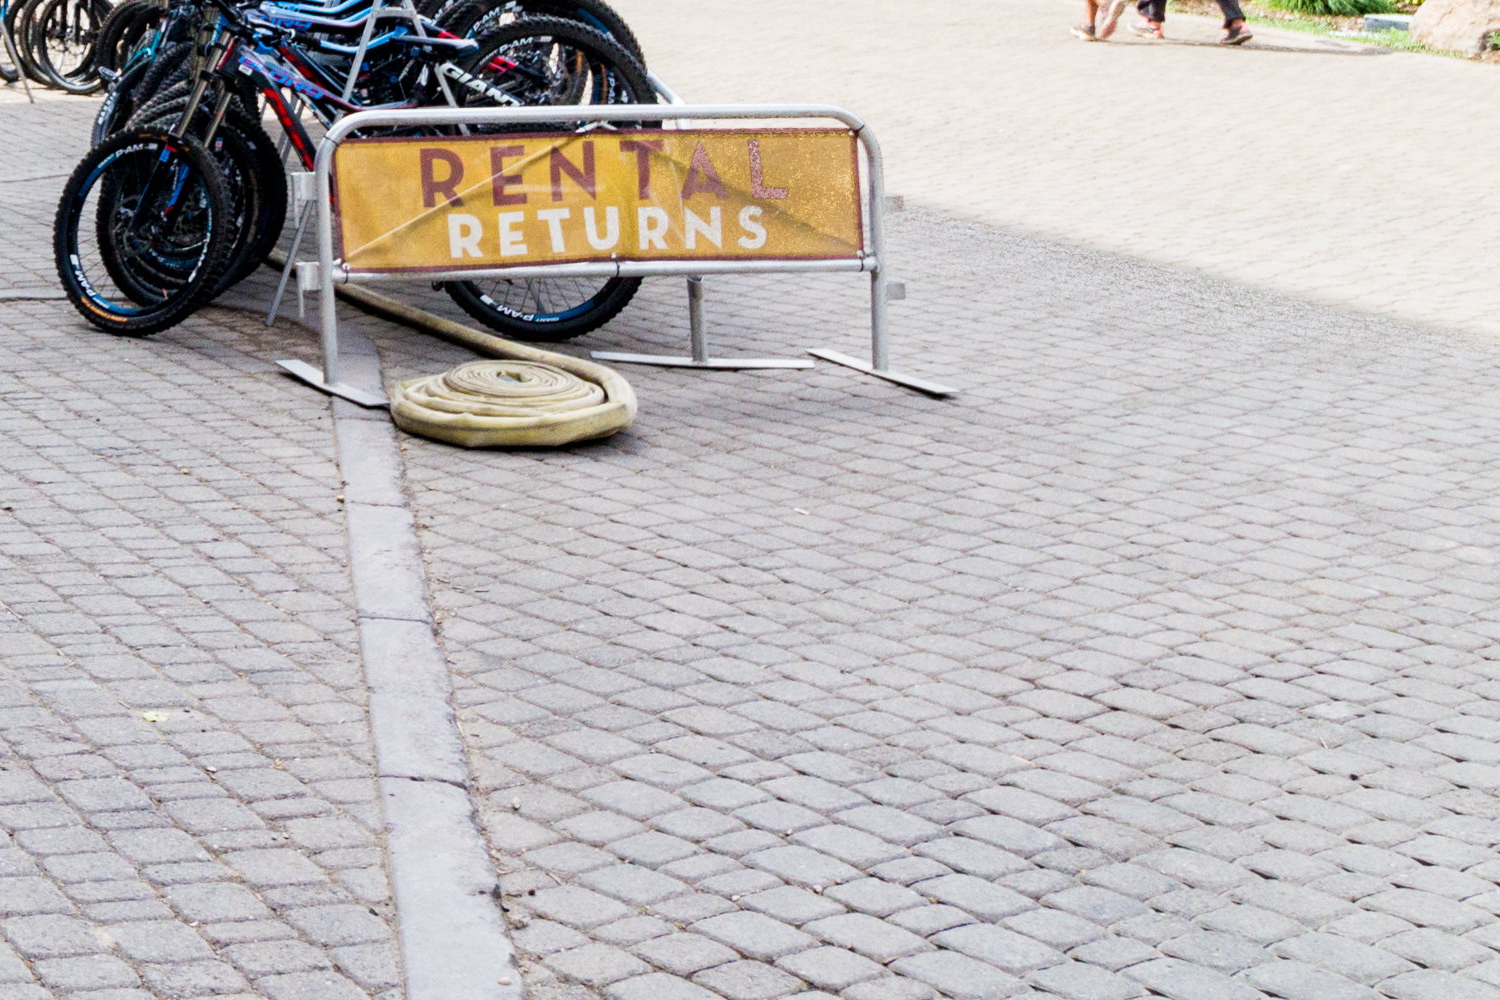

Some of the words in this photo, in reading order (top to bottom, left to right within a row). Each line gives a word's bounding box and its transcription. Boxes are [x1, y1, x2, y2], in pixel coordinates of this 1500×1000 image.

[238, 55, 323, 100] GLORY
[439, 61, 524, 107] GIANT
[418, 139, 788, 208] RENTAL
[447, 205, 768, 258] RETURNS
